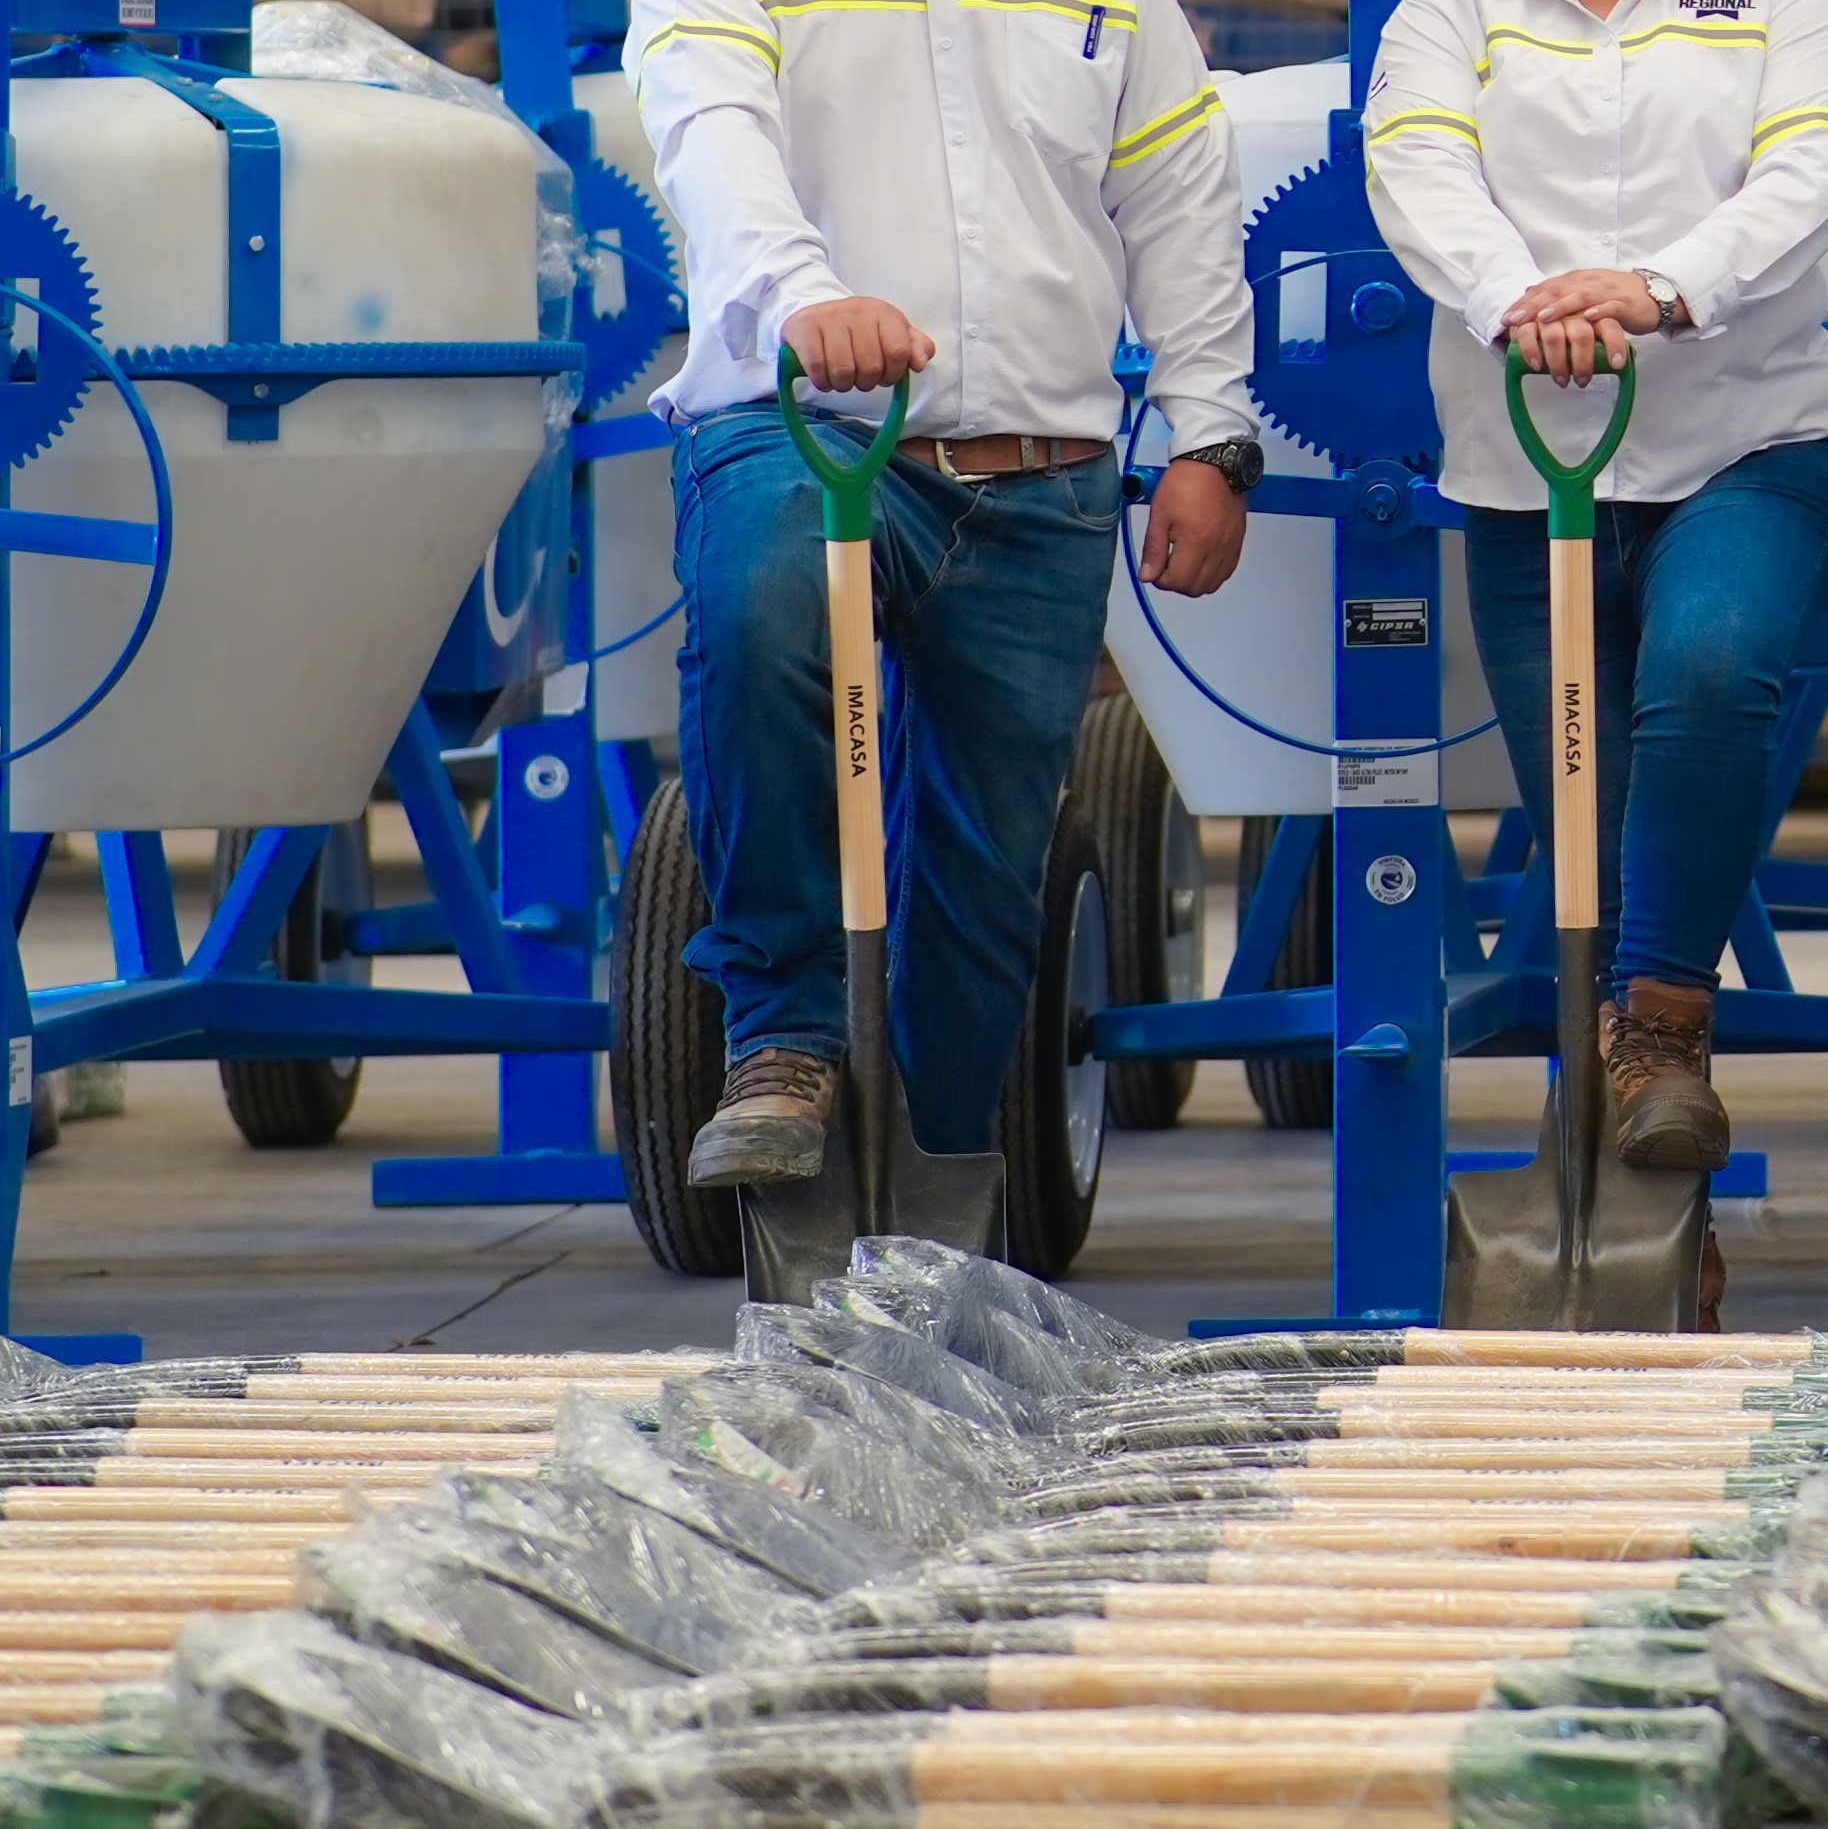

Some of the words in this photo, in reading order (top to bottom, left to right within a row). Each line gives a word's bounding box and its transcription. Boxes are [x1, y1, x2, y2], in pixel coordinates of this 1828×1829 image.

[1369, 621, 1415, 631] CIPSA
[847, 684, 867, 778] IMACASA
[1564, 682, 1582, 776] IMACASA
